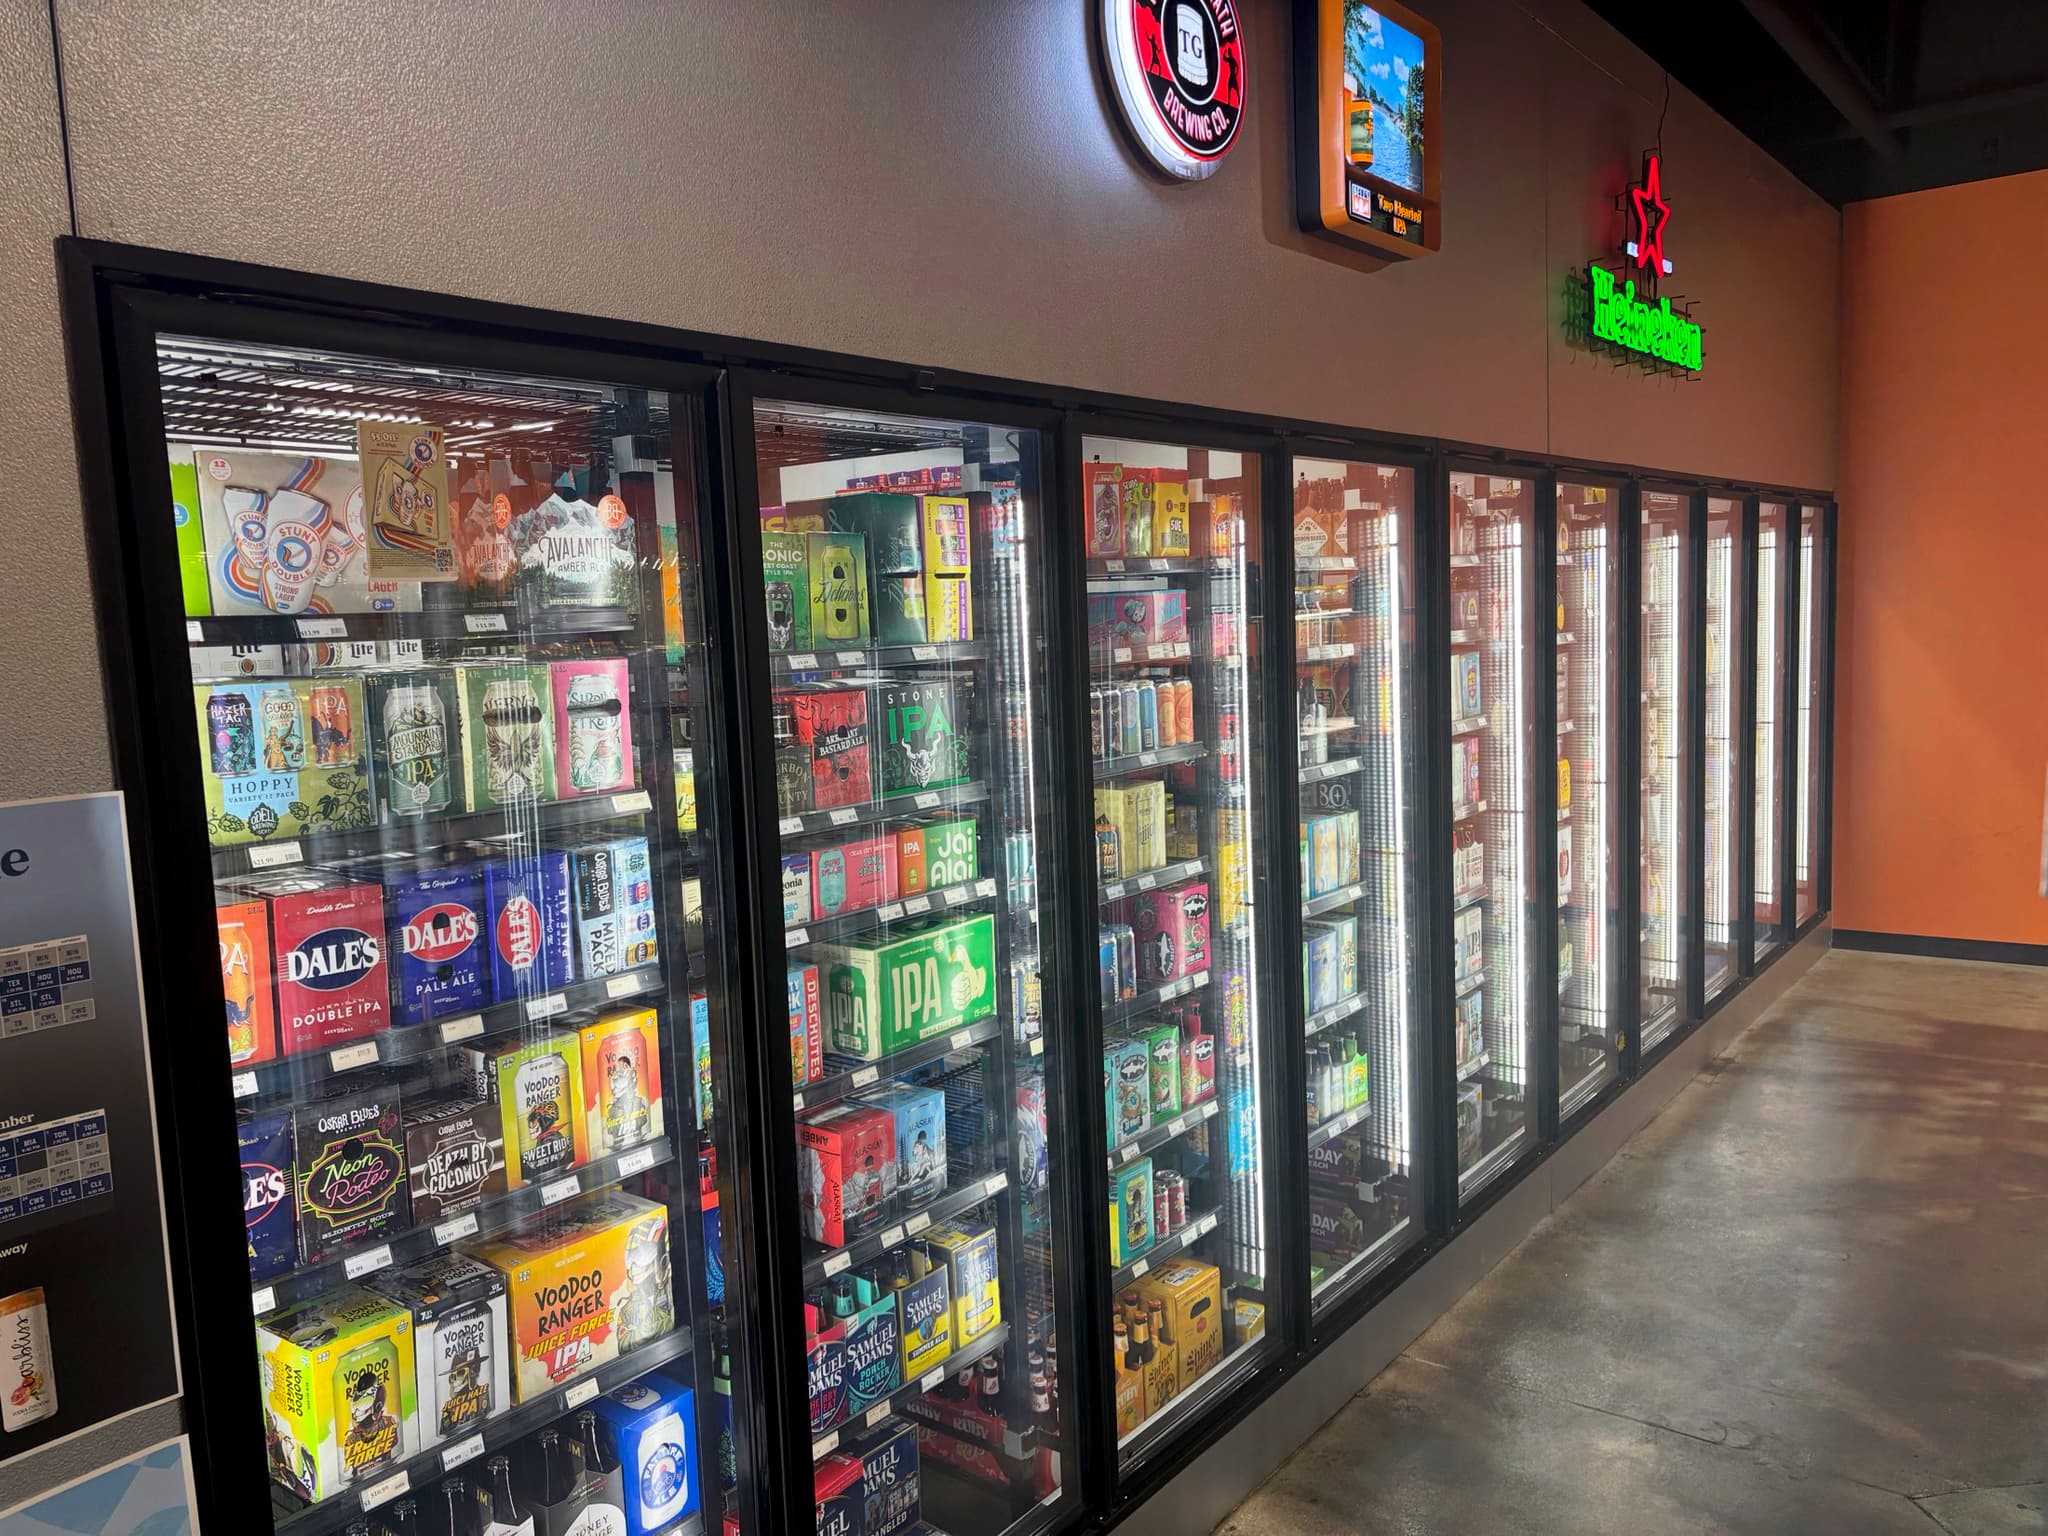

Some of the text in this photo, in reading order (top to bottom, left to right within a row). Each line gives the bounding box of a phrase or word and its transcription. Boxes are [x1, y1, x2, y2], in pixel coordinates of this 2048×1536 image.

[1179, 29, 1203, 59] TG
[1164, 88, 1230, 141] BREWING CO.
[1378, 194, 1394, 213] Two
[1394, 200, 1422, 223] Hearted
[1394, 216, 1407, 235] IPA
[1592, 266, 1702, 371] Heineken
[213, 460, 226, 468] 12
[238, 514, 265, 524] STUNT
[1170, 518, 1184, 532] SUE
[279, 526, 317, 547] STUNT
[770, 541, 784, 549] THE
[539, 536, 614, 567] AVALANCHE
[761, 550, 803, 562] ONIC
[271, 561, 313, 583] DOUBLE
[558, 561, 586, 574] AMBER
[274, 582, 299, 594] STRONG
[275, 591, 295, 602] LAGER
[368, 581, 398, 593] LAGER
[814, 581, 866, 604] Delicious
[349, 643, 374, 657] Lite
[396, 641, 418, 655] Lite
[266, 702, 296, 713] GOOD
[315, 697, 347, 716] IPA
[887, 688, 947, 704] STONE
[211, 703, 247, 719] HAZER
[216, 714, 241, 724] TAG
[887, 704, 954, 745] IPA
[392, 728, 440, 750] MOUNTAIN
[394, 739, 442, 760] STANDARD
[820, 736, 864, 756] BASTARD ALE
[406, 758, 436, 784] IPA
[232, 778, 294, 794] HOPPY
[228, 795, 263, 803] VARIETY
[251, 808, 276, 825] ODELL
[903, 841, 920, 855] IPA
[937, 827, 973, 858] Jai
[595, 852, 611, 912] OSKAR BLUES
[930, 854, 973, 887] Alai
[419, 878, 458, 890] The Original
[306, 905, 333, 915] Double
[402, 912, 480, 954] DALE'S
[508, 896, 534, 970] DALE'S
[560, 888, 570, 957] PALE ALE
[591, 930, 605, 973] PACK
[602, 921, 615, 974] MIXED
[287, 937, 381, 982] DALE'S
[8, 979, 21, 987] TEX
[37, 972, 52, 981] HOU
[67, 967, 82, 976] HOU
[416, 972, 476, 996] PALE ALE
[891, 957, 943, 1033] IPA
[40, 993, 53, 1001] STL
[293, 1001, 382, 1028] DOUBLE IPA
[831, 992, 866, 1037] IPA
[806, 980, 821, 1079] DESCHUTES
[524, 1075, 561, 1094] VOODOO
[526, 1086, 561, 1109] RANGER
[84, 1123, 97, 1131] TOR
[318, 1105, 380, 1133] OSKAR BLUES
[908, 1118, 936, 1137] ALASKAN
[24, 1138, 37, 1147] MIA
[54, 1130, 67, 1138] TOR
[472, 1142, 487, 1162] BY
[523, 1136, 572, 1164] SWEET RIDE
[854, 1138, 884, 1160] ALASKAN
[1315, 1147, 1342, 1166] DAY
[59, 1169, 70, 1177] PIT
[90, 1180, 103, 1188] CLE
[320, 1153, 379, 1192] Neon
[326, 1160, 390, 1208] Rodeo
[430, 1160, 489, 1195] COCONUT
[29, 1196, 45, 1205] CWS
[60, 1188, 73, 1197] CLE
[832, 1179, 842, 1225] ALASKAN
[322, 1210, 395, 1240] SLIGHTLY SOUR
[1312, 1214, 1340, 1232] DAY
[964, 1258, 991, 1280] SAMUEL
[535, 1270, 603, 1311] VOODOO
[907, 1286, 944, 1318] SAMUEL
[344, 1304, 392, 1323] VOODOO
[538, 1290, 605, 1338] RANGER
[911, 1300, 943, 1328] ADAMS
[444, 1321, 484, 1344] VOODOO
[524, 1313, 616, 1362] JUICE FORCE
[848, 1323, 897, 1363] SAMUEL
[12, 1314, 36, 1388] carbliss
[445, 1333, 485, 1359] RANGER
[554, 1336, 591, 1370] IPA
[911, 1334, 946, 1358] SUMMER ALE
[1187, 1327, 1218, 1373] Shiner
[852, 1340, 893, 1376] ADAMS
[860, 1359, 886, 1380] PORCH
[1149, 1348, 1175, 1386] Shiner
[344, 1358, 389, 1385] VOODOO
[859, 1366, 890, 1391] ROCKER
[284, 1363, 296, 1414] RANGER
[293, 1369, 304, 1418] VOODOO
[809, 1370, 842, 1399] DAMS
[442, 1385, 488, 1411] JUICY HAZE
[451, 1402, 477, 1422] IPA
[952, 1416, 990, 1440] RUBY
[346, 1423, 398, 1457] TROPIC
[344, 1436, 395, 1473] FORCE
[654, 1487, 677, 1506] ALE
